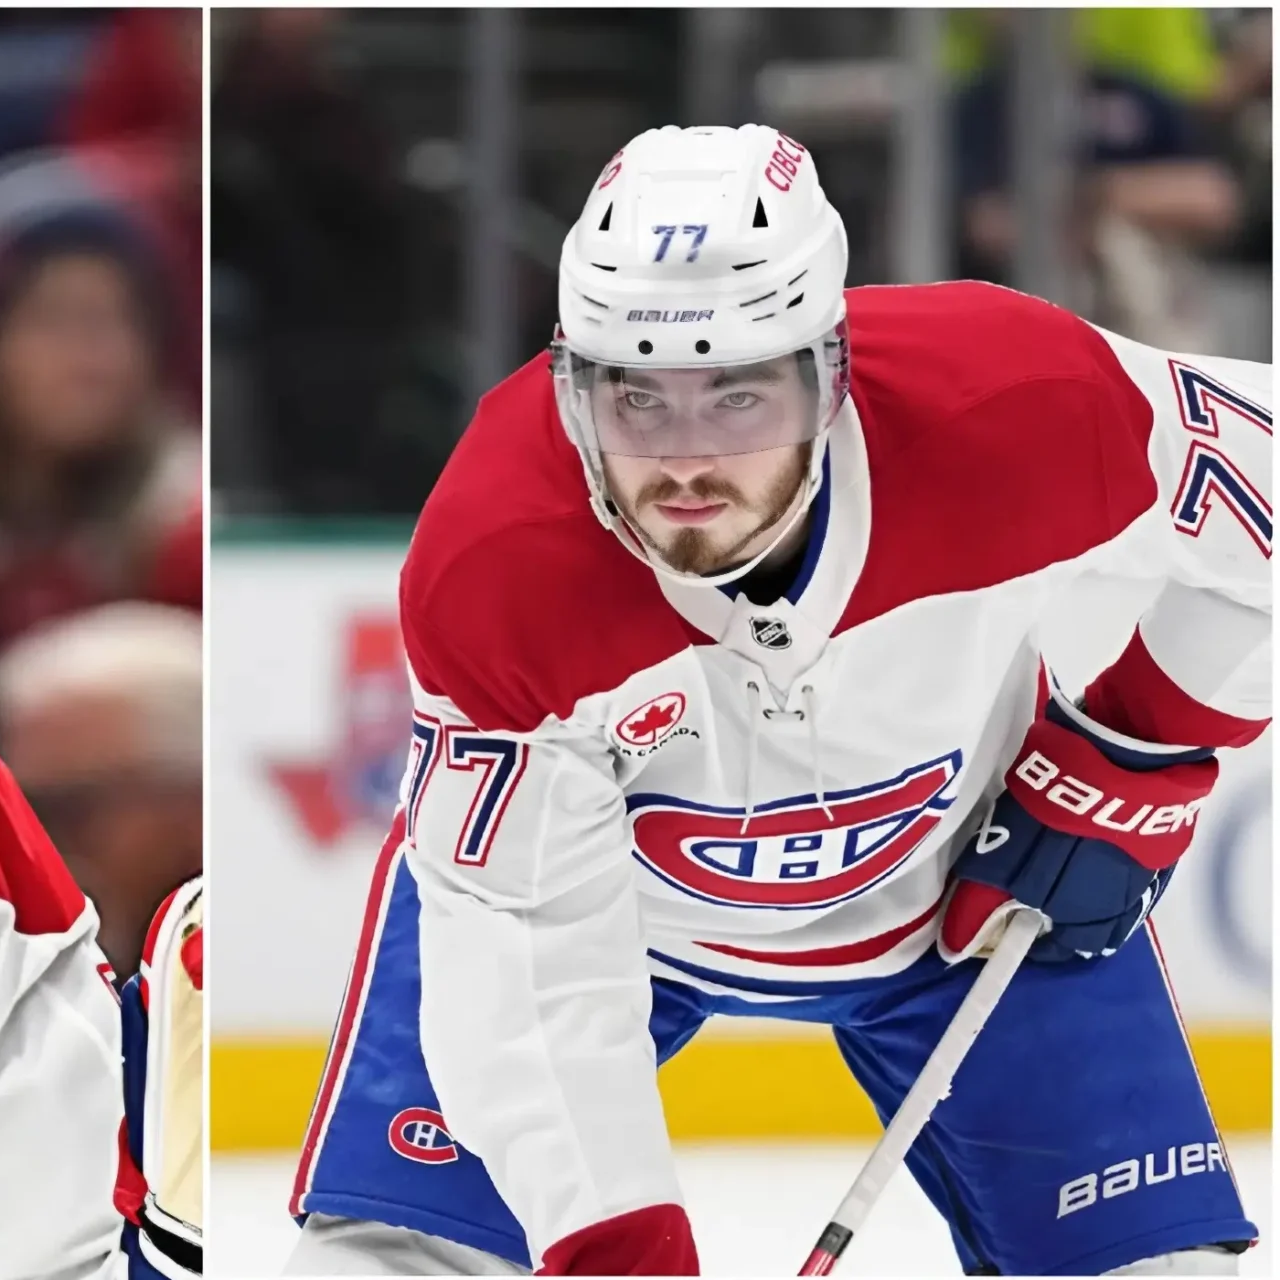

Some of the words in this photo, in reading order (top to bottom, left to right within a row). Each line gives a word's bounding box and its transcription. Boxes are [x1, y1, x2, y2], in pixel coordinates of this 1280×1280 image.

[651, 224, 709, 262] 77
[1168, 358, 1273, 560] 77
[409, 708, 528, 868] 77
